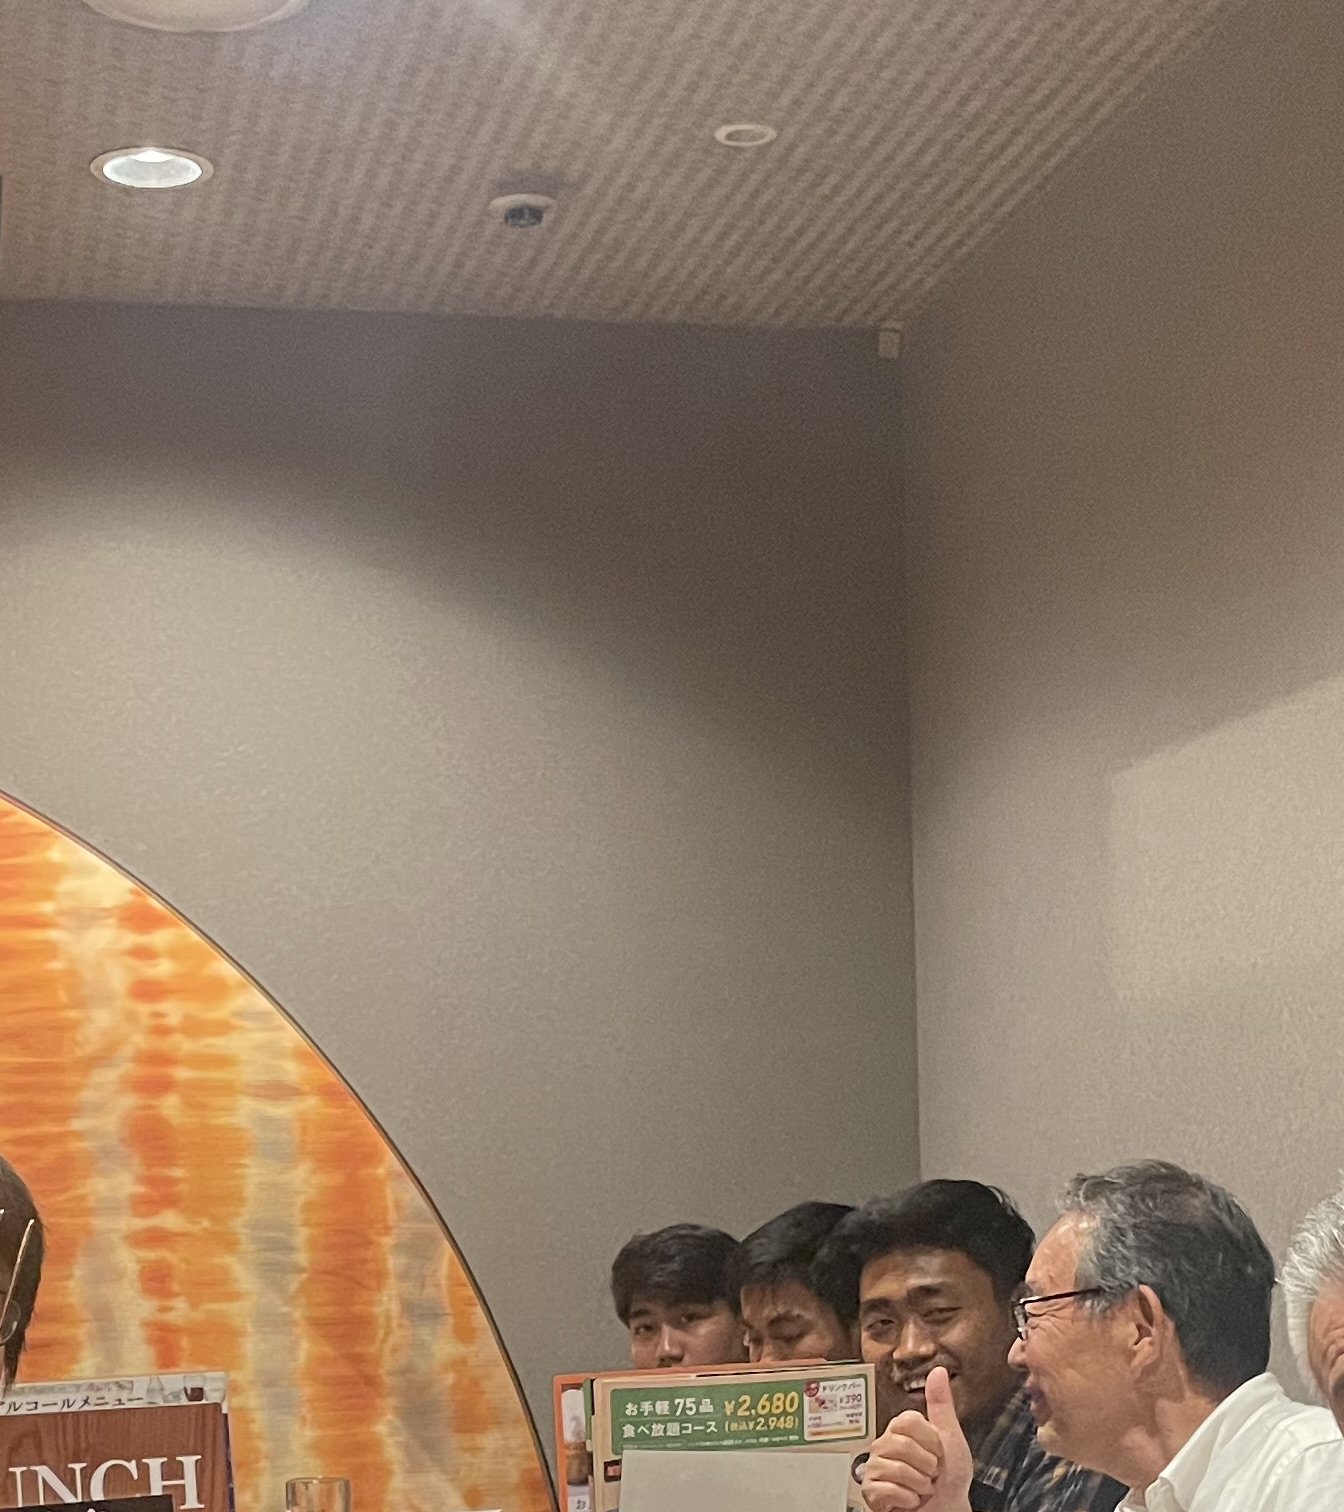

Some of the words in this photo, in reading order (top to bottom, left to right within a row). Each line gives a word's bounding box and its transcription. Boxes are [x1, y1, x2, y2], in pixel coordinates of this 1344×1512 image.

[724, 1391, 799, 1417] ¥2,680
[622, 1421, 718, 1438] 食べ放題コース
